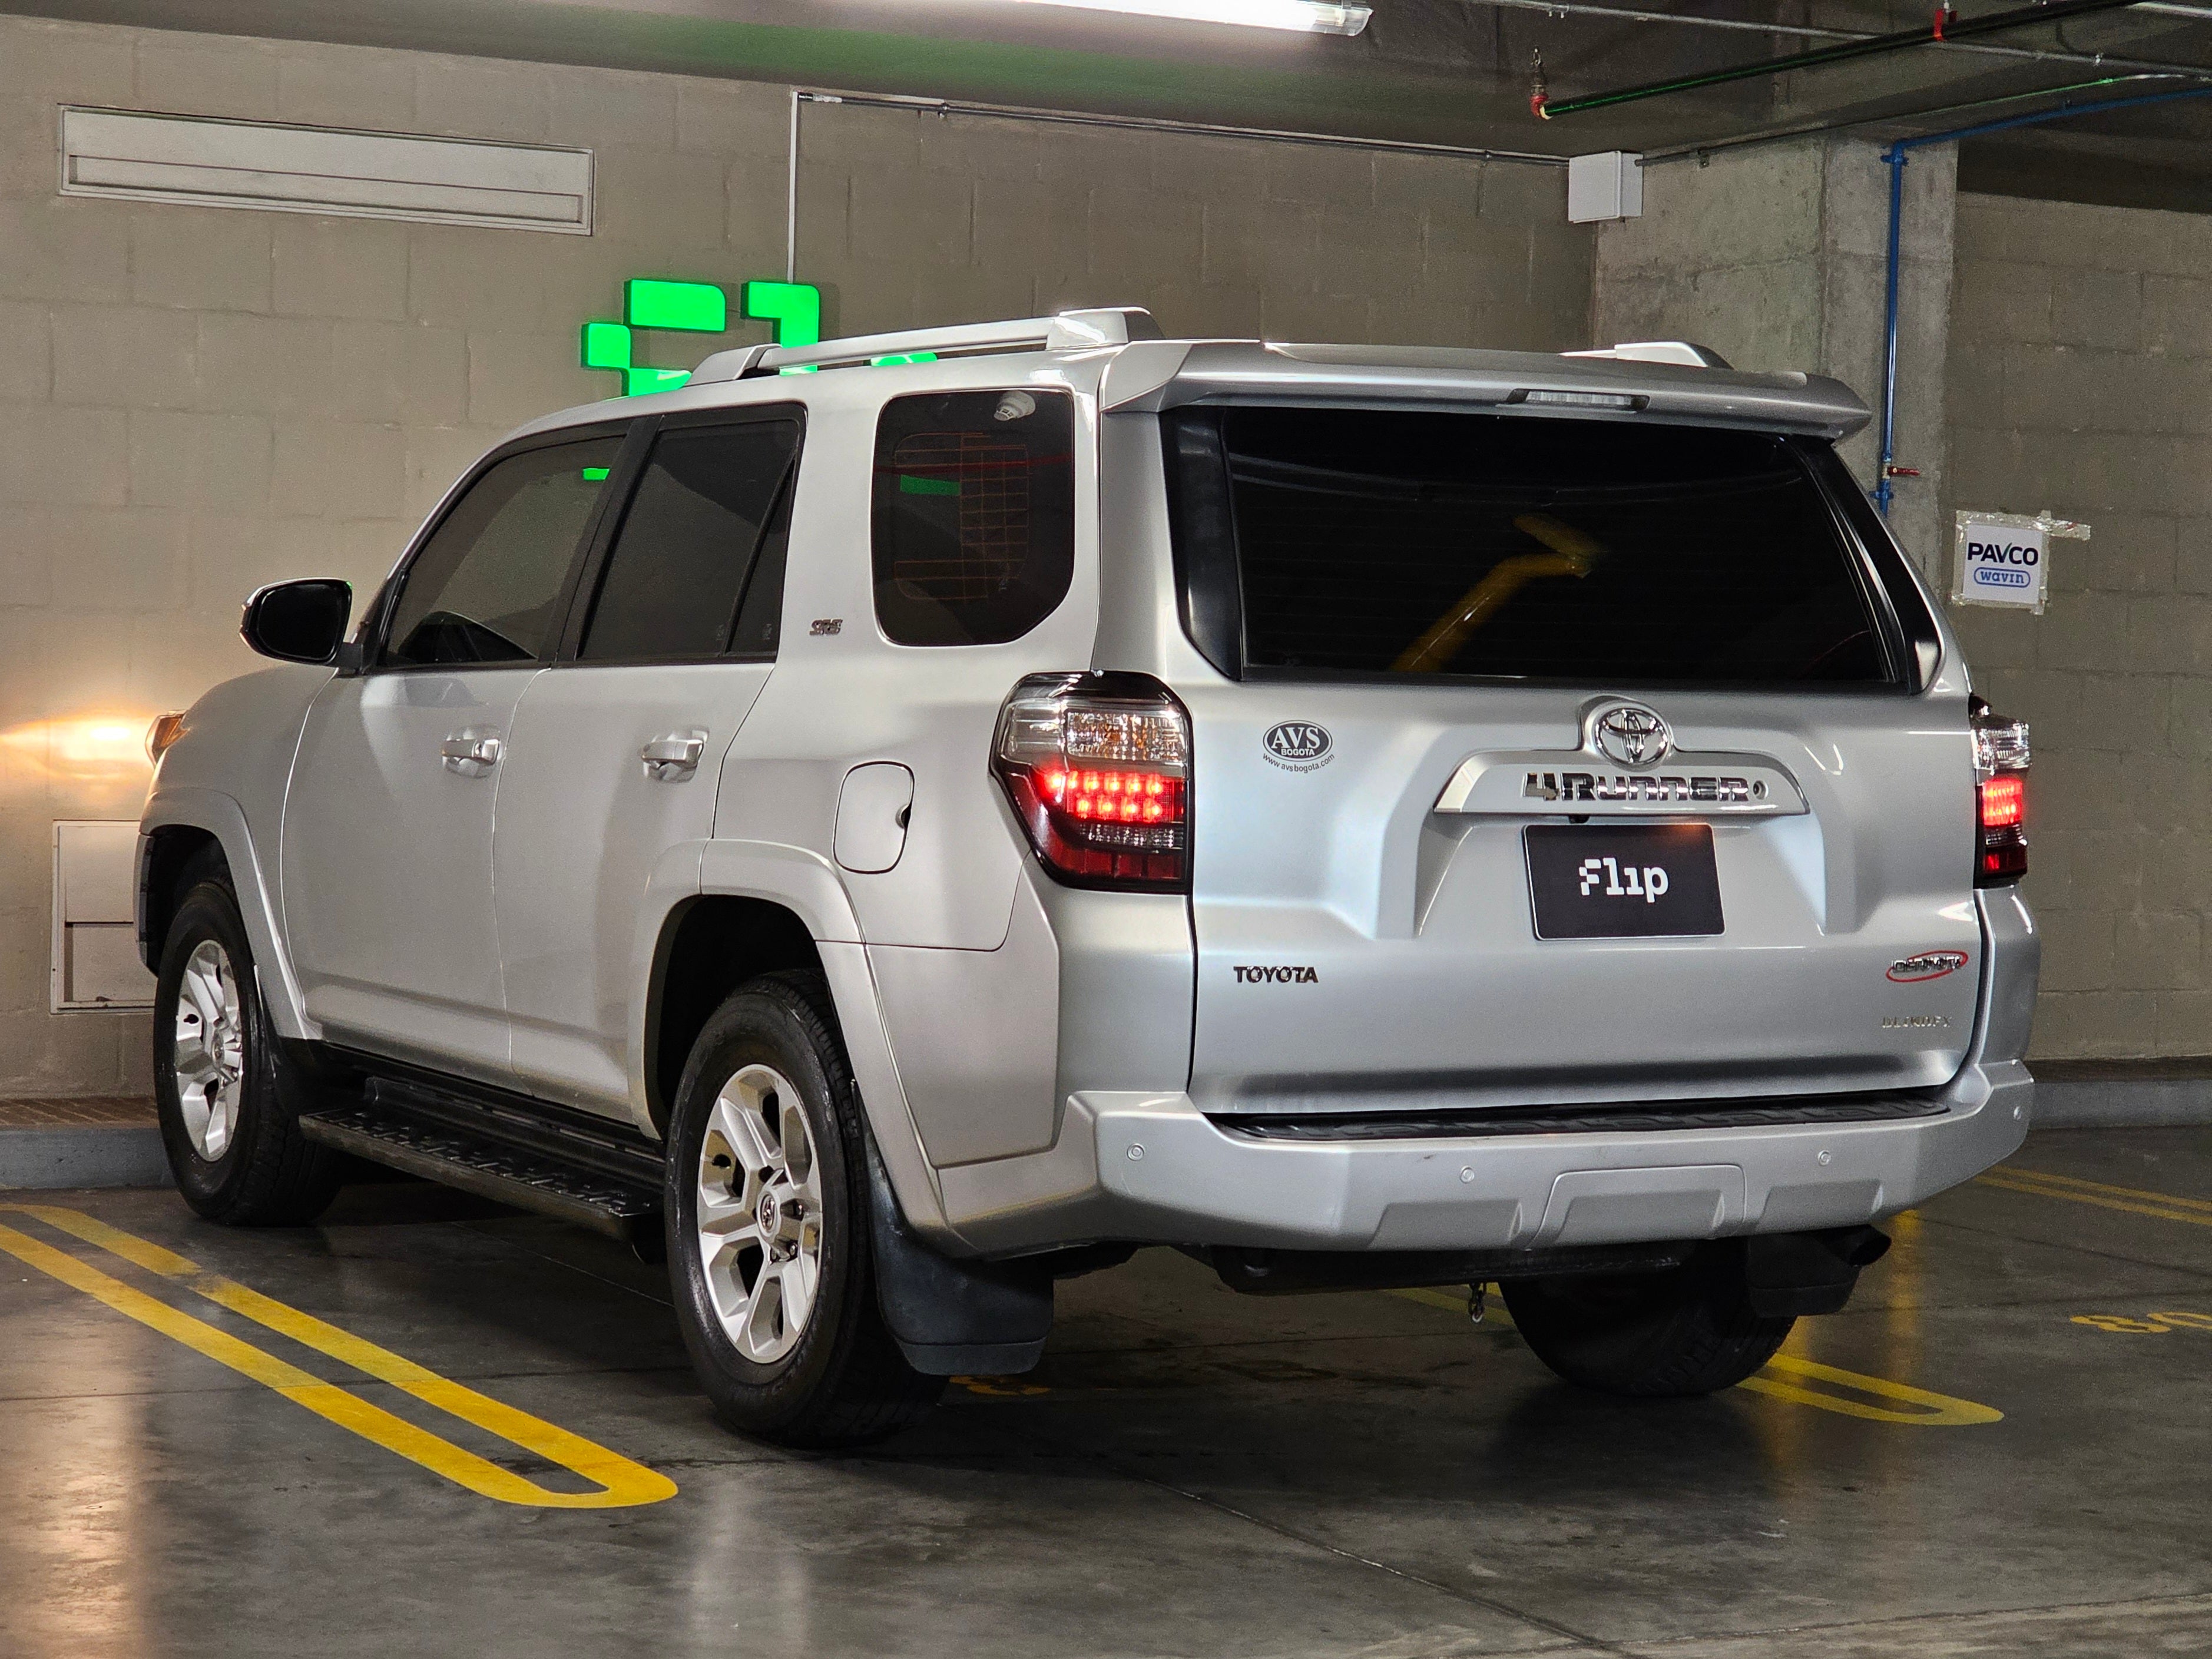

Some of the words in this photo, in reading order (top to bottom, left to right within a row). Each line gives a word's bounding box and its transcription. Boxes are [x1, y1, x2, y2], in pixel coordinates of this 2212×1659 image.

[1967, 542, 2039, 566] PAVCO
[1980, 571, 2025, 584] wavin
[1271, 727, 1320, 749] AVS
[1281, 748, 1315, 756] BOGOTA
[1579, 857, 1669, 903] Flip
[1233, 966, 1319, 984] TOYOTA
